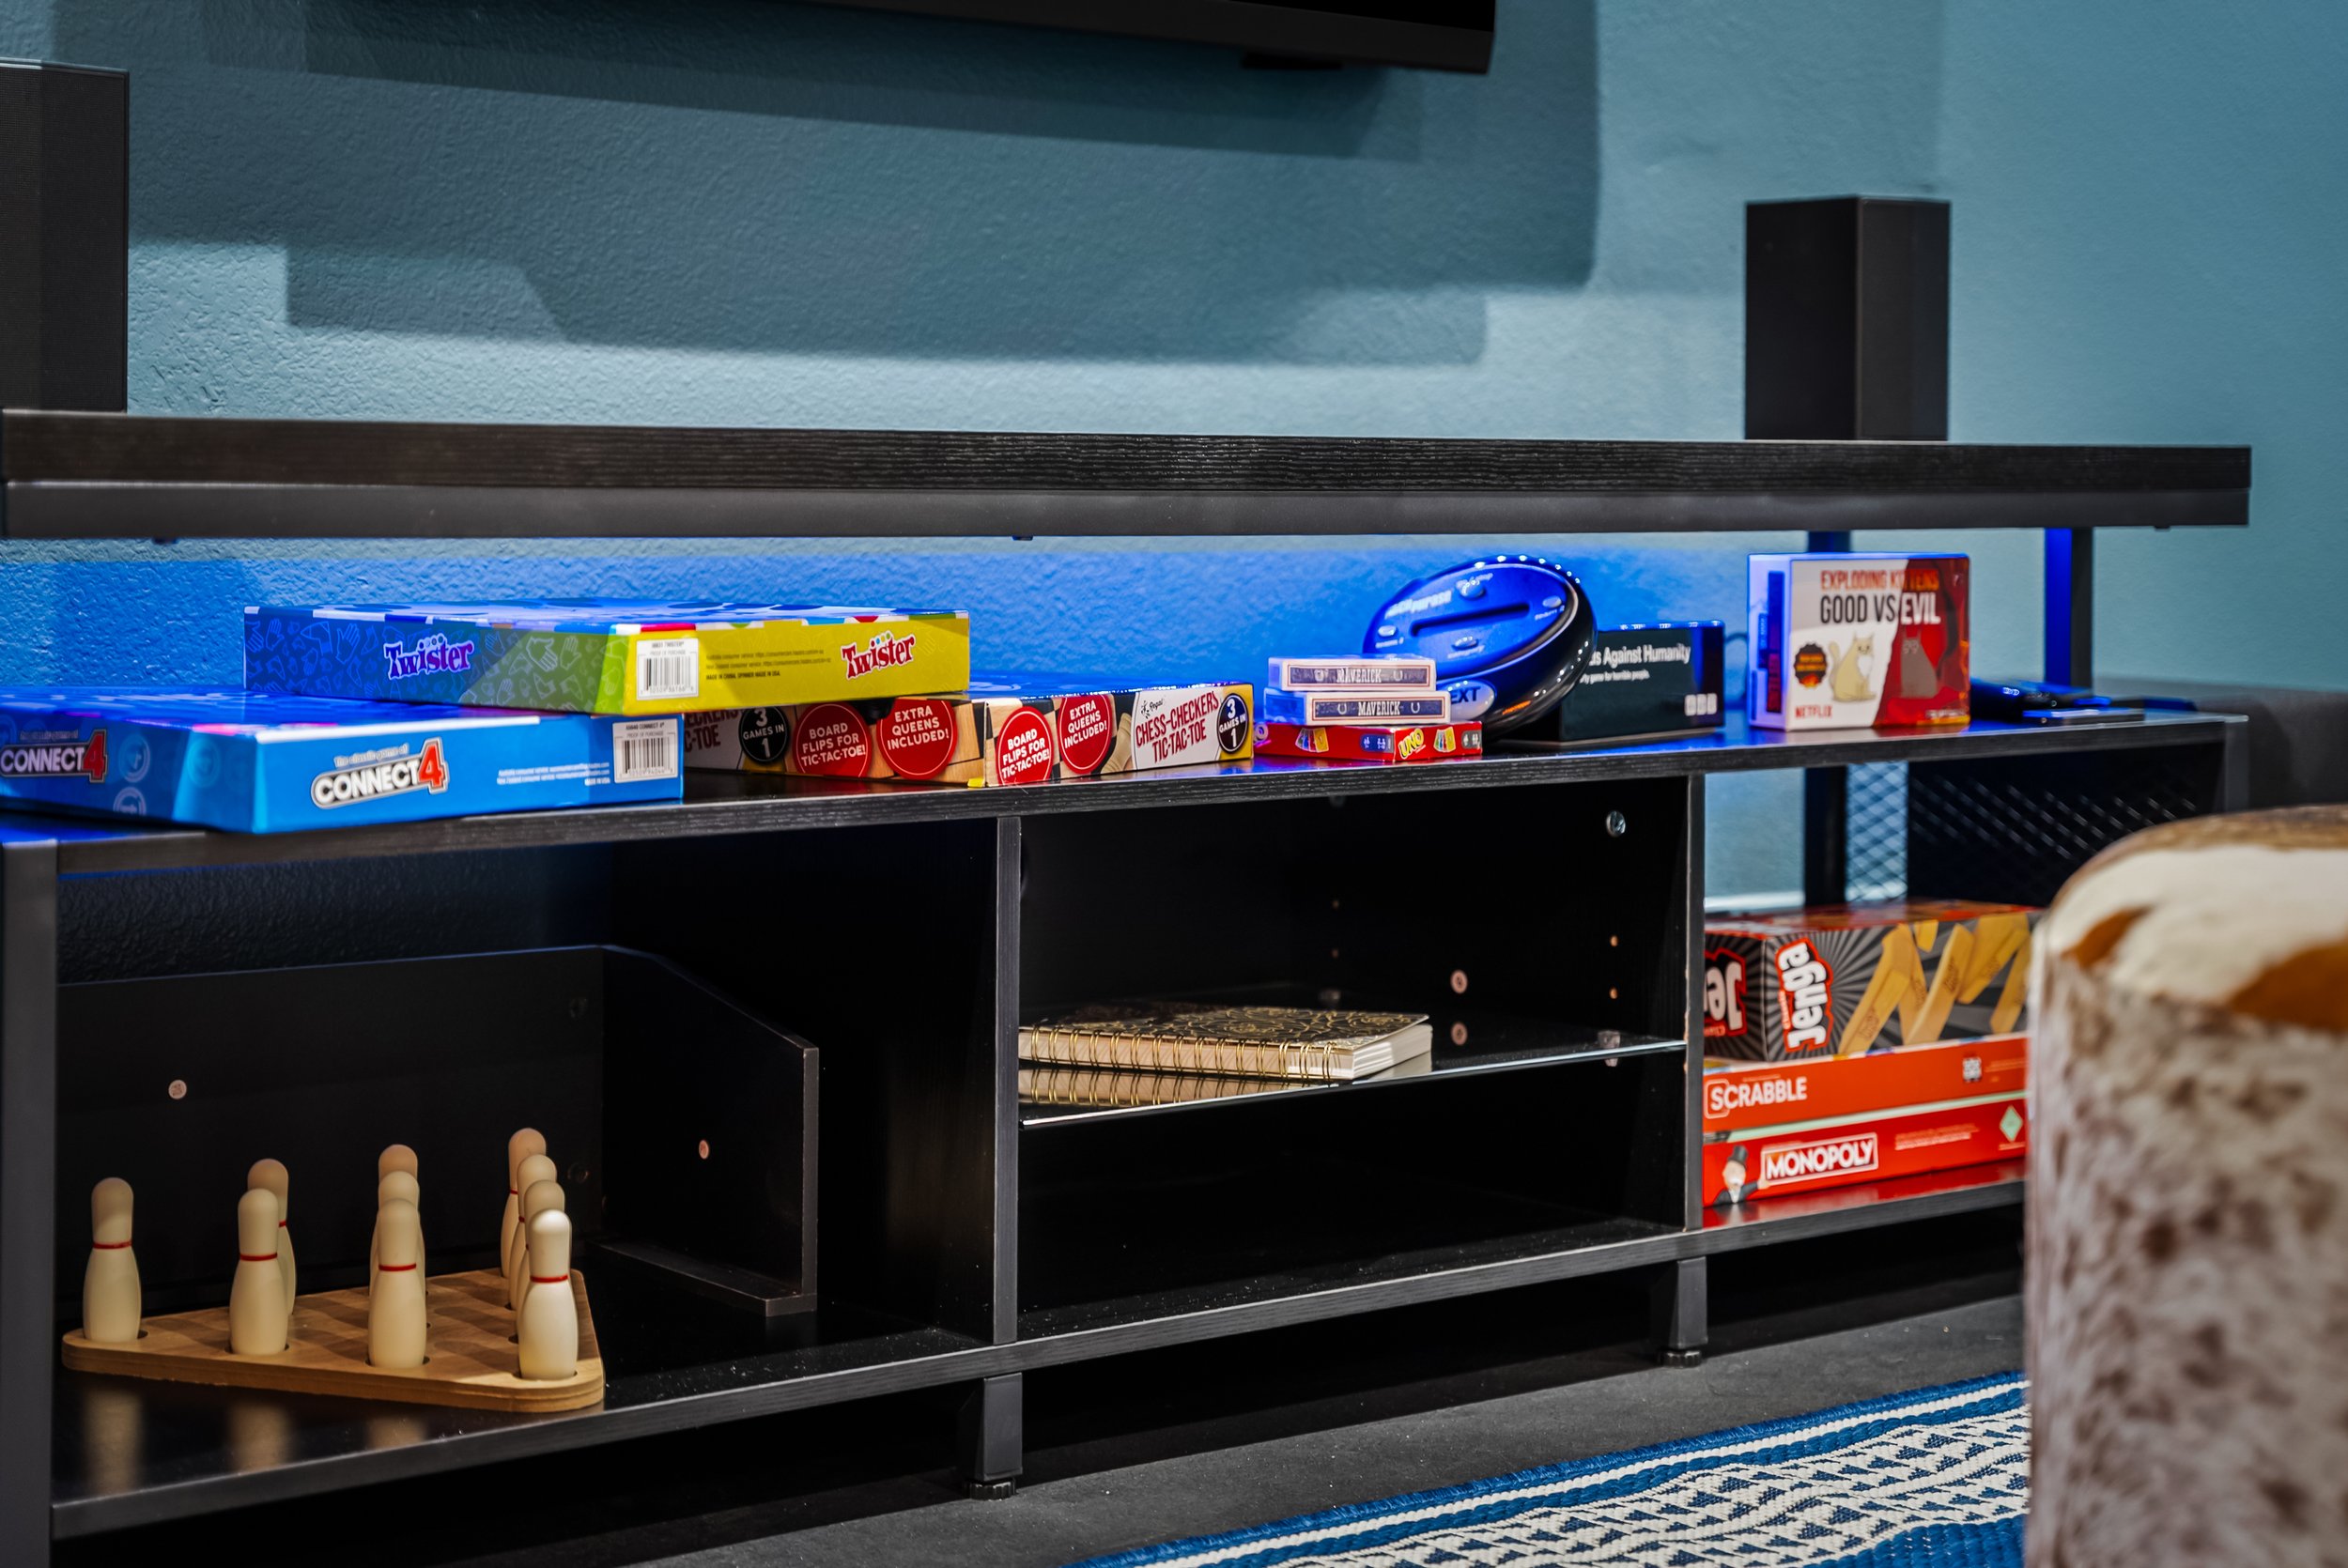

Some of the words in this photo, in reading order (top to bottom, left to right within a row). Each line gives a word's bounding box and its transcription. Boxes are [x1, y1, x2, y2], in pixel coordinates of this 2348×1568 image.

[1820, 594, 1868, 624] GOOD
[1874, 594, 1897, 623] VS
[1901, 592, 1940, 625] EVIL
[384, 635, 474, 679] Twister
[842, 634, 916, 678] Twister
[1603, 645, 1643, 669] Against
[1643, 643, 1691, 664] Humanity
[1336, 668, 1382, 684] MAVERICK
[1451, 686, 1481, 703] EXT
[754, 707, 768, 727] 3
[894, 705, 933, 723] EXTRA
[1070, 699, 1097, 720] EXTRA
[1227, 698, 1236, 719] 3
[1358, 701, 1400, 716] MAVERICK
[1795, 705, 1832, 719] NETFLIX
[743, 727, 773, 740] GAMES
[775, 723, 785, 732] IN
[809, 722, 848, 740] BOARD
[892, 716, 940, 736] QUEENS
[1068, 711, 1101, 733] QUEENS
[1219, 716, 1239, 733] GAMES
[1240, 714, 1246, 723] IN
[802, 738, 834, 754] FLIPS
[837, 732, 859, 745] FOR
[887, 728, 950, 751] INCLUDED!
[1007, 728, 1038, 750] BOARD
[1064, 720, 1107, 749] INCLUDED!
[1230, 729, 1237, 747] 1
[1398, 728, 1425, 759] UNO
[1, 746, 85, 773] CONNECT
[82, 731, 106, 780] 4
[762, 738, 770, 758] 1
[1002, 746, 1027, 765] FLIPS
[1028, 737, 1045, 751] FOR
[315, 759, 420, 804] CONNECT
[418, 743, 445, 789] 4
[1778, 942, 1828, 1049] Jenga
[1710, 1077, 1807, 1111] SCRABBLE
[1766, 1139, 1875, 1180] MONOPOLY
